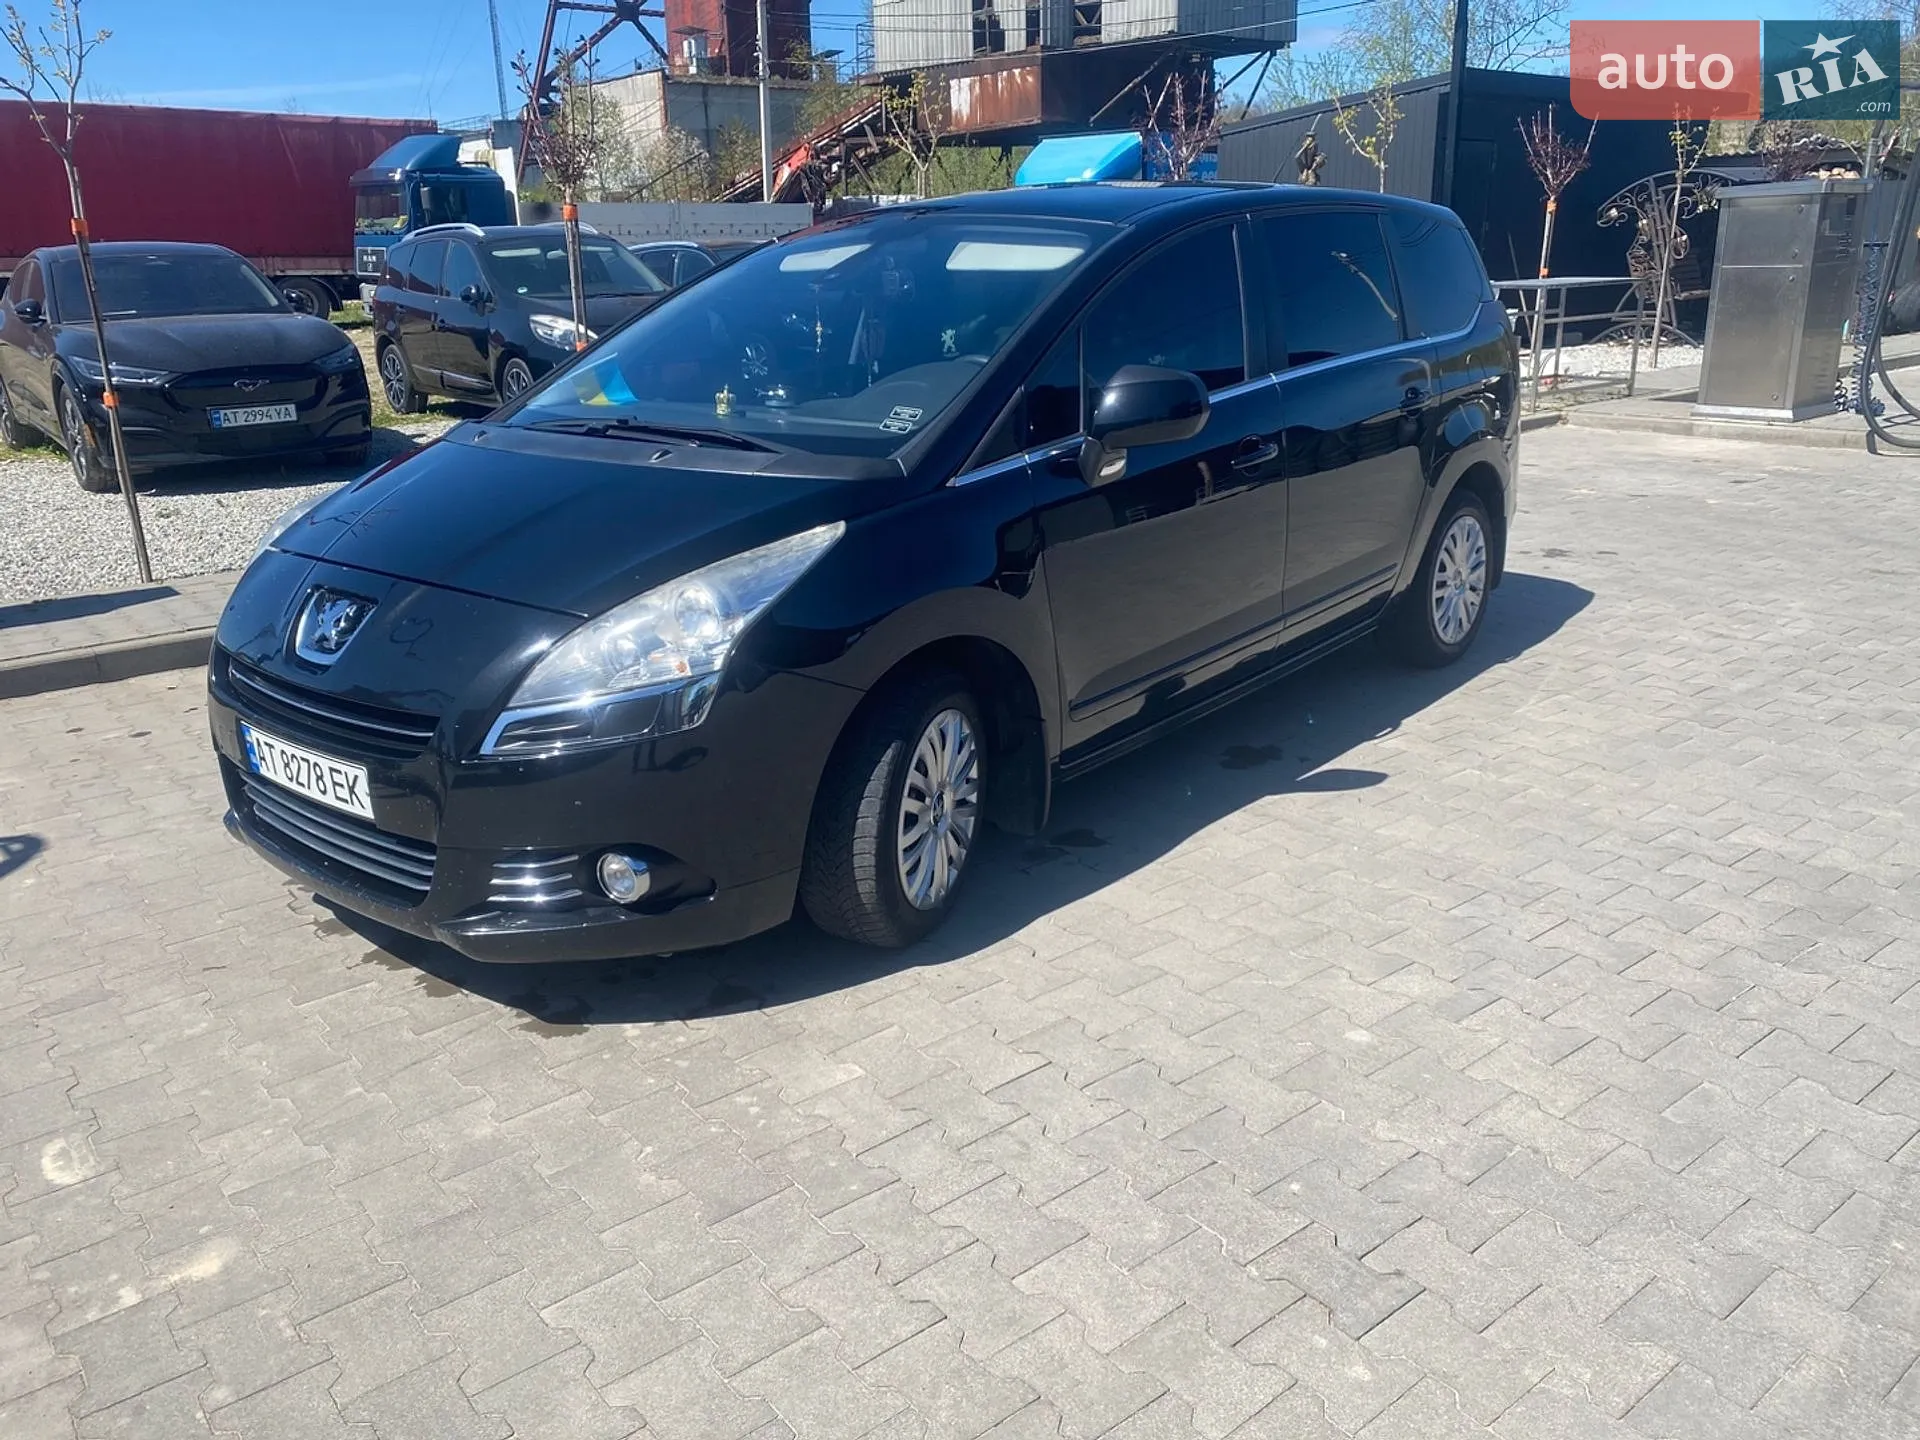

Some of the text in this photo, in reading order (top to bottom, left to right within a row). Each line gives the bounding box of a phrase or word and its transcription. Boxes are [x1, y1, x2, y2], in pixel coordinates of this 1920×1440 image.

[222, 406, 293, 424] AT 2994 YA
[256, 738, 366, 810] AT 8278 EK
